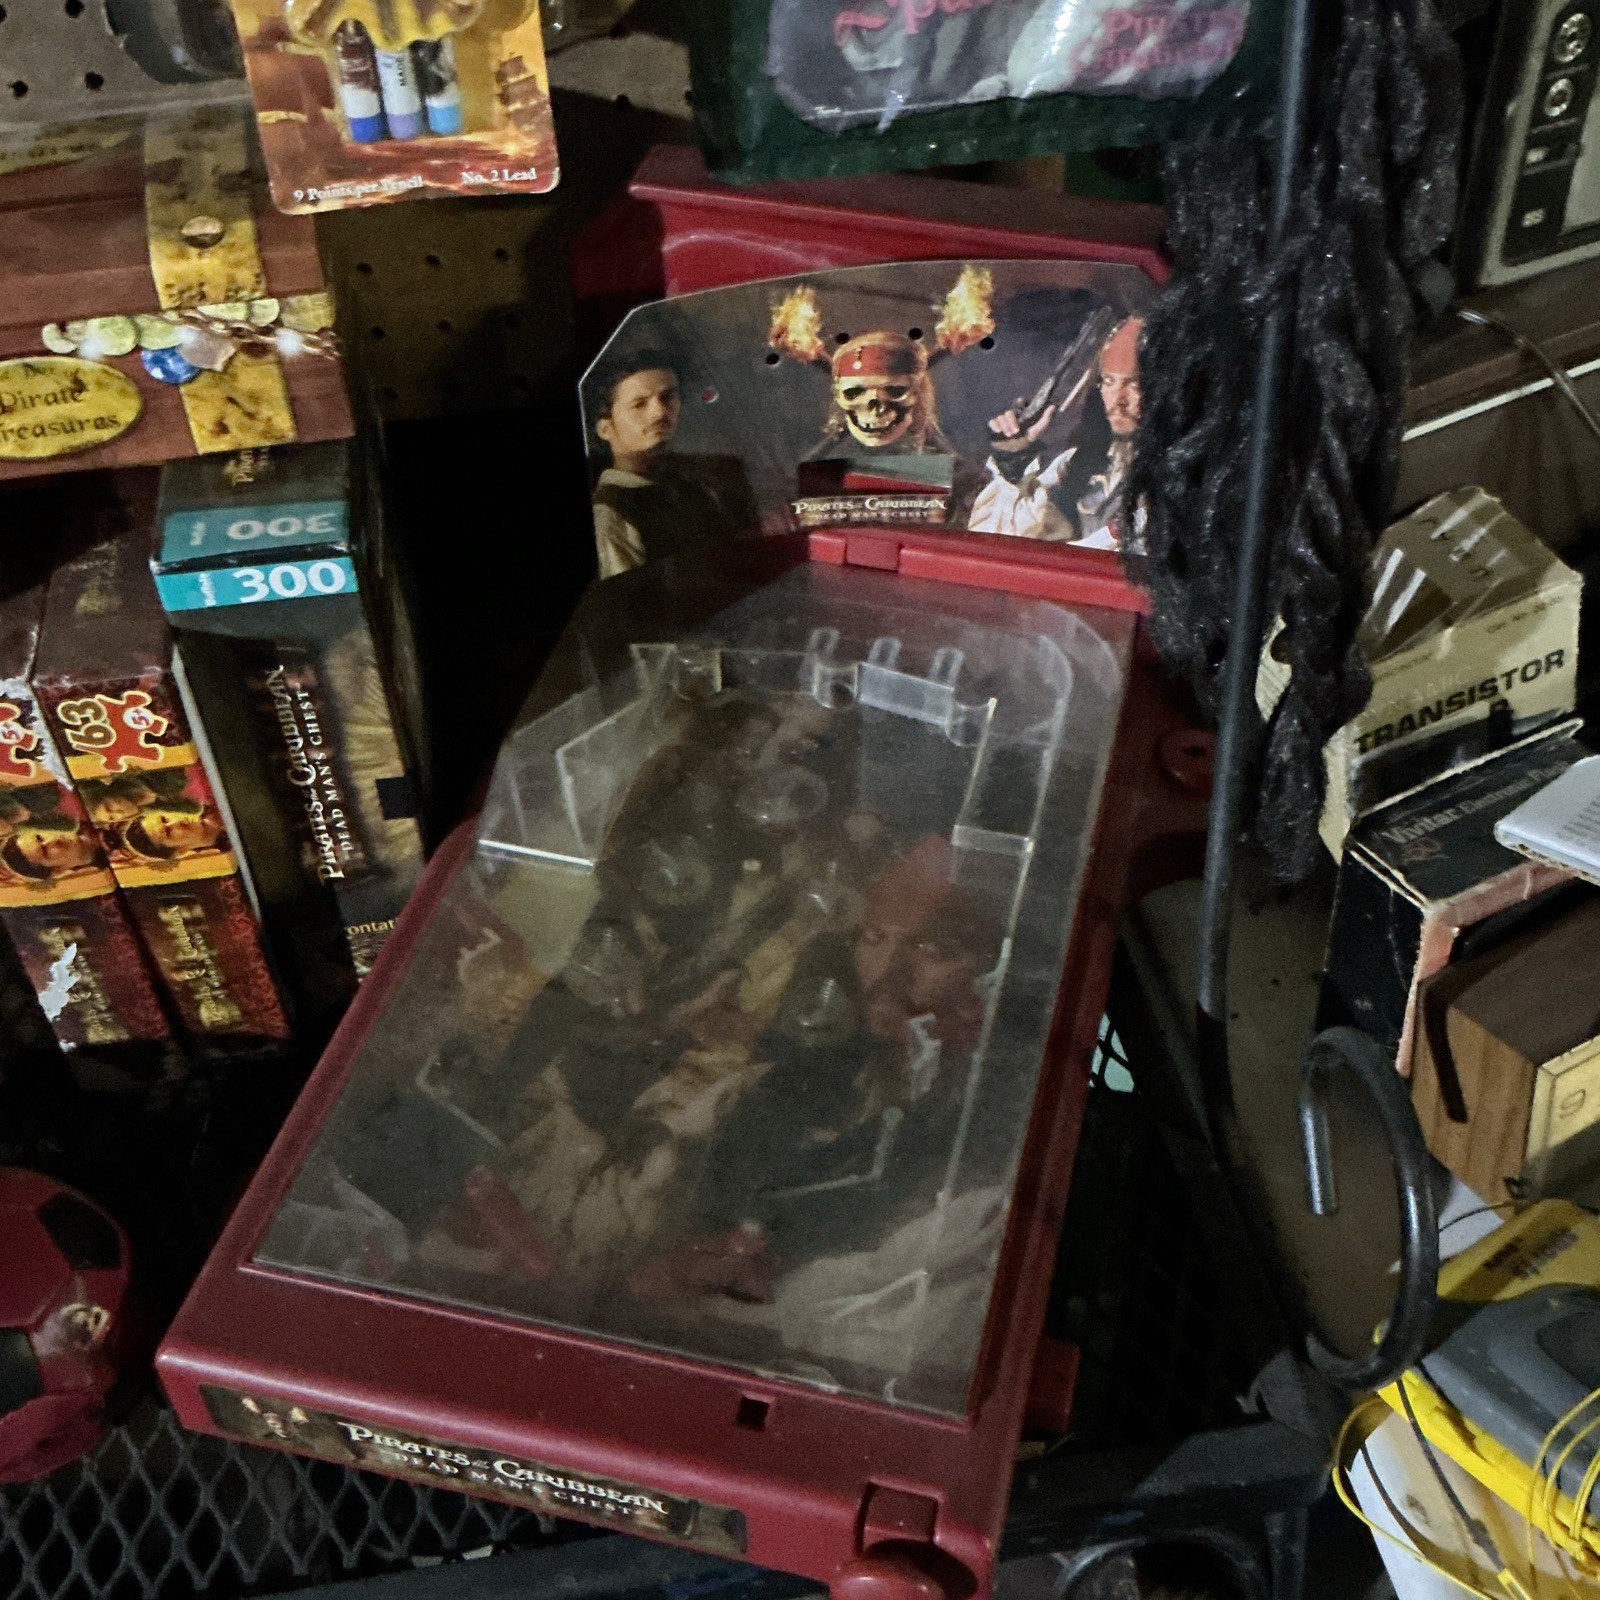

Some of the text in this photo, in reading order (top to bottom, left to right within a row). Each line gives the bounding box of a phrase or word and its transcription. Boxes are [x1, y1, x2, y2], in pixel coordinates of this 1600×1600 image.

[293, 190, 304, 202] 9
[461, 168, 537, 185] No. 2 Lead
[232, 560, 347, 604] 300
[57, 697, 117, 749] 63
[296, 690, 323, 746] CHEST
[1355, 649, 1565, 756] TRANSISTOR
[331, 808, 353, 852] DEAD
[337, 1420, 668, 1514] PIRATES CARIBBEAN
[393, 1453, 459, 1475] DEAD
[472, 1471, 543, 1494] MAN'S
[553, 1490, 635, 1516] CHEST
